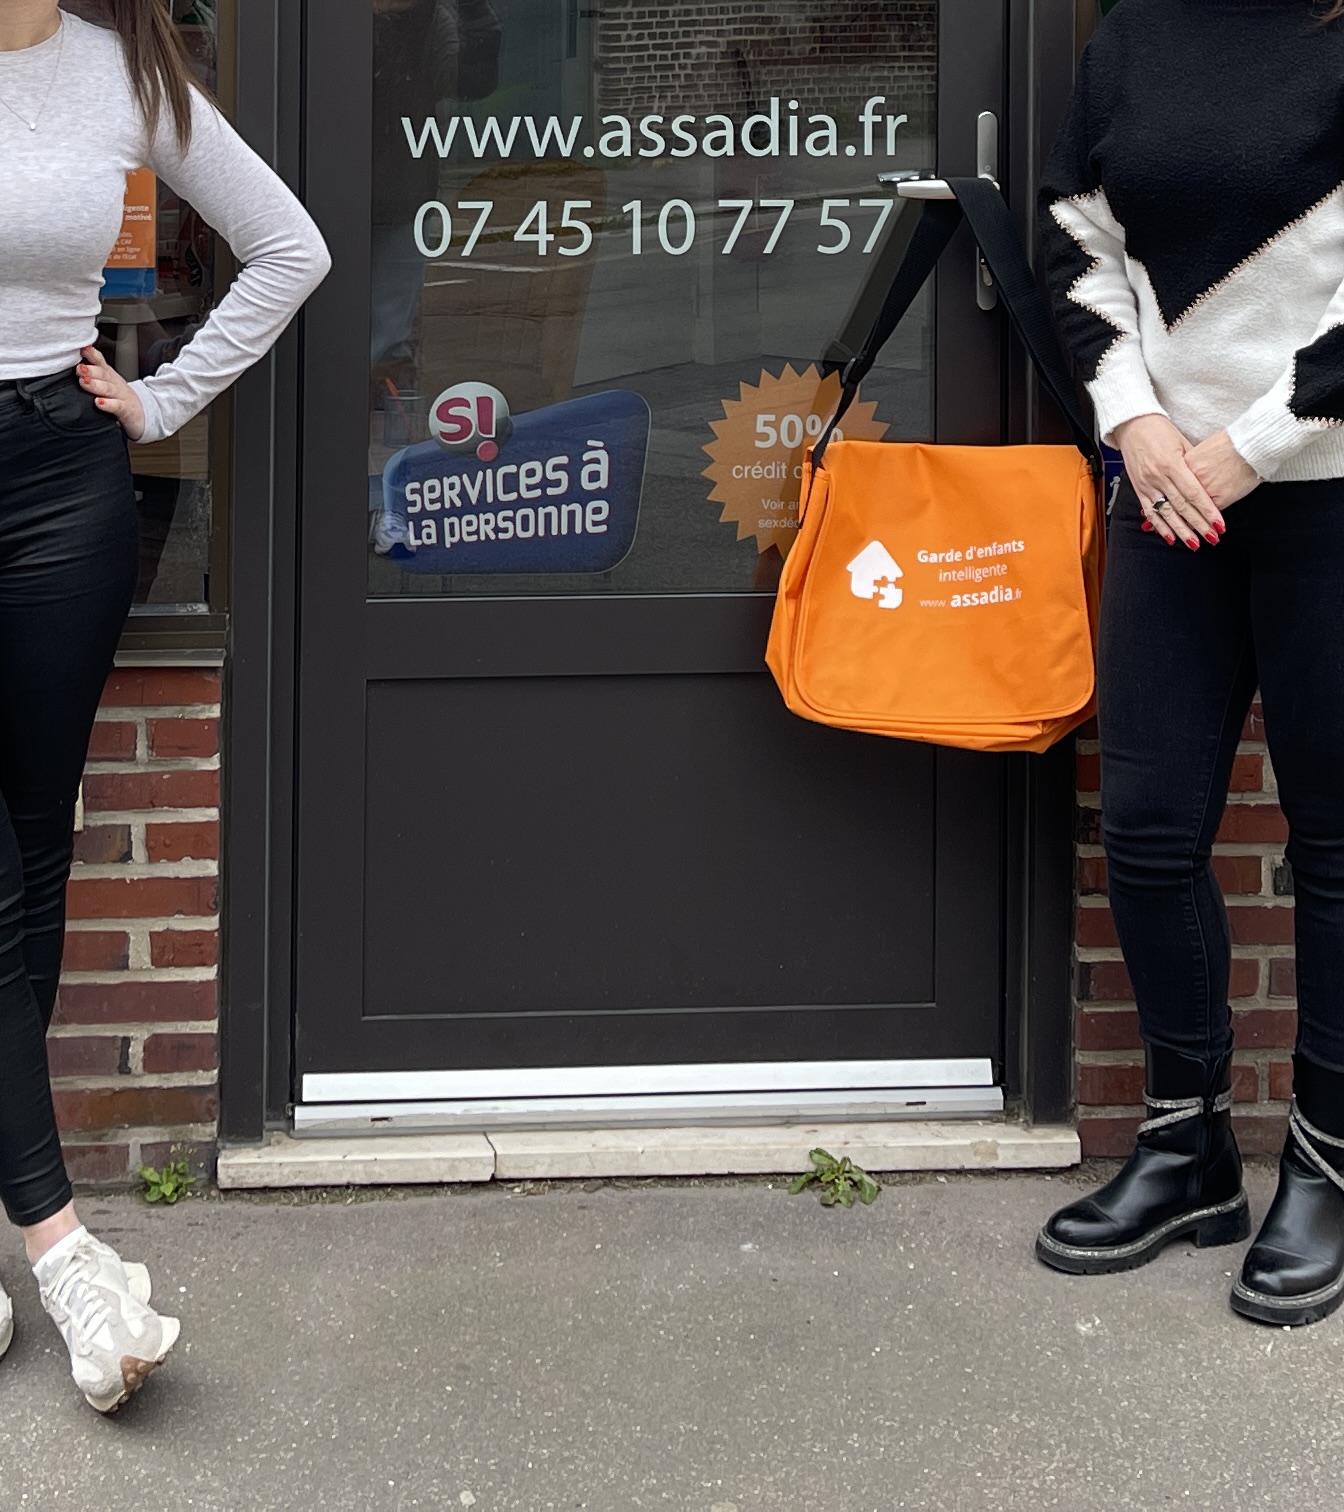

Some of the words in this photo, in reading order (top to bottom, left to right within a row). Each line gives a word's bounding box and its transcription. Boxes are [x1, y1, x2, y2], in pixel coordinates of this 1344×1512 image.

[401, 96, 908, 159] www.assadia.fr
[413, 200, 495, 258] 07
[513, 199, 594, 257] 45
[621, 198, 697, 256] 10
[717, 199, 795, 256] 77
[816, 198, 895, 255] 57
[754, 413, 844, 449] 50%
[732, 460, 787, 480] crédit
[761, 498, 784, 510] Voir
[917, 549, 963, 563] Garde
[965, 539, 1026, 562] d'enfants
[938, 563, 1008, 583] intelligente
